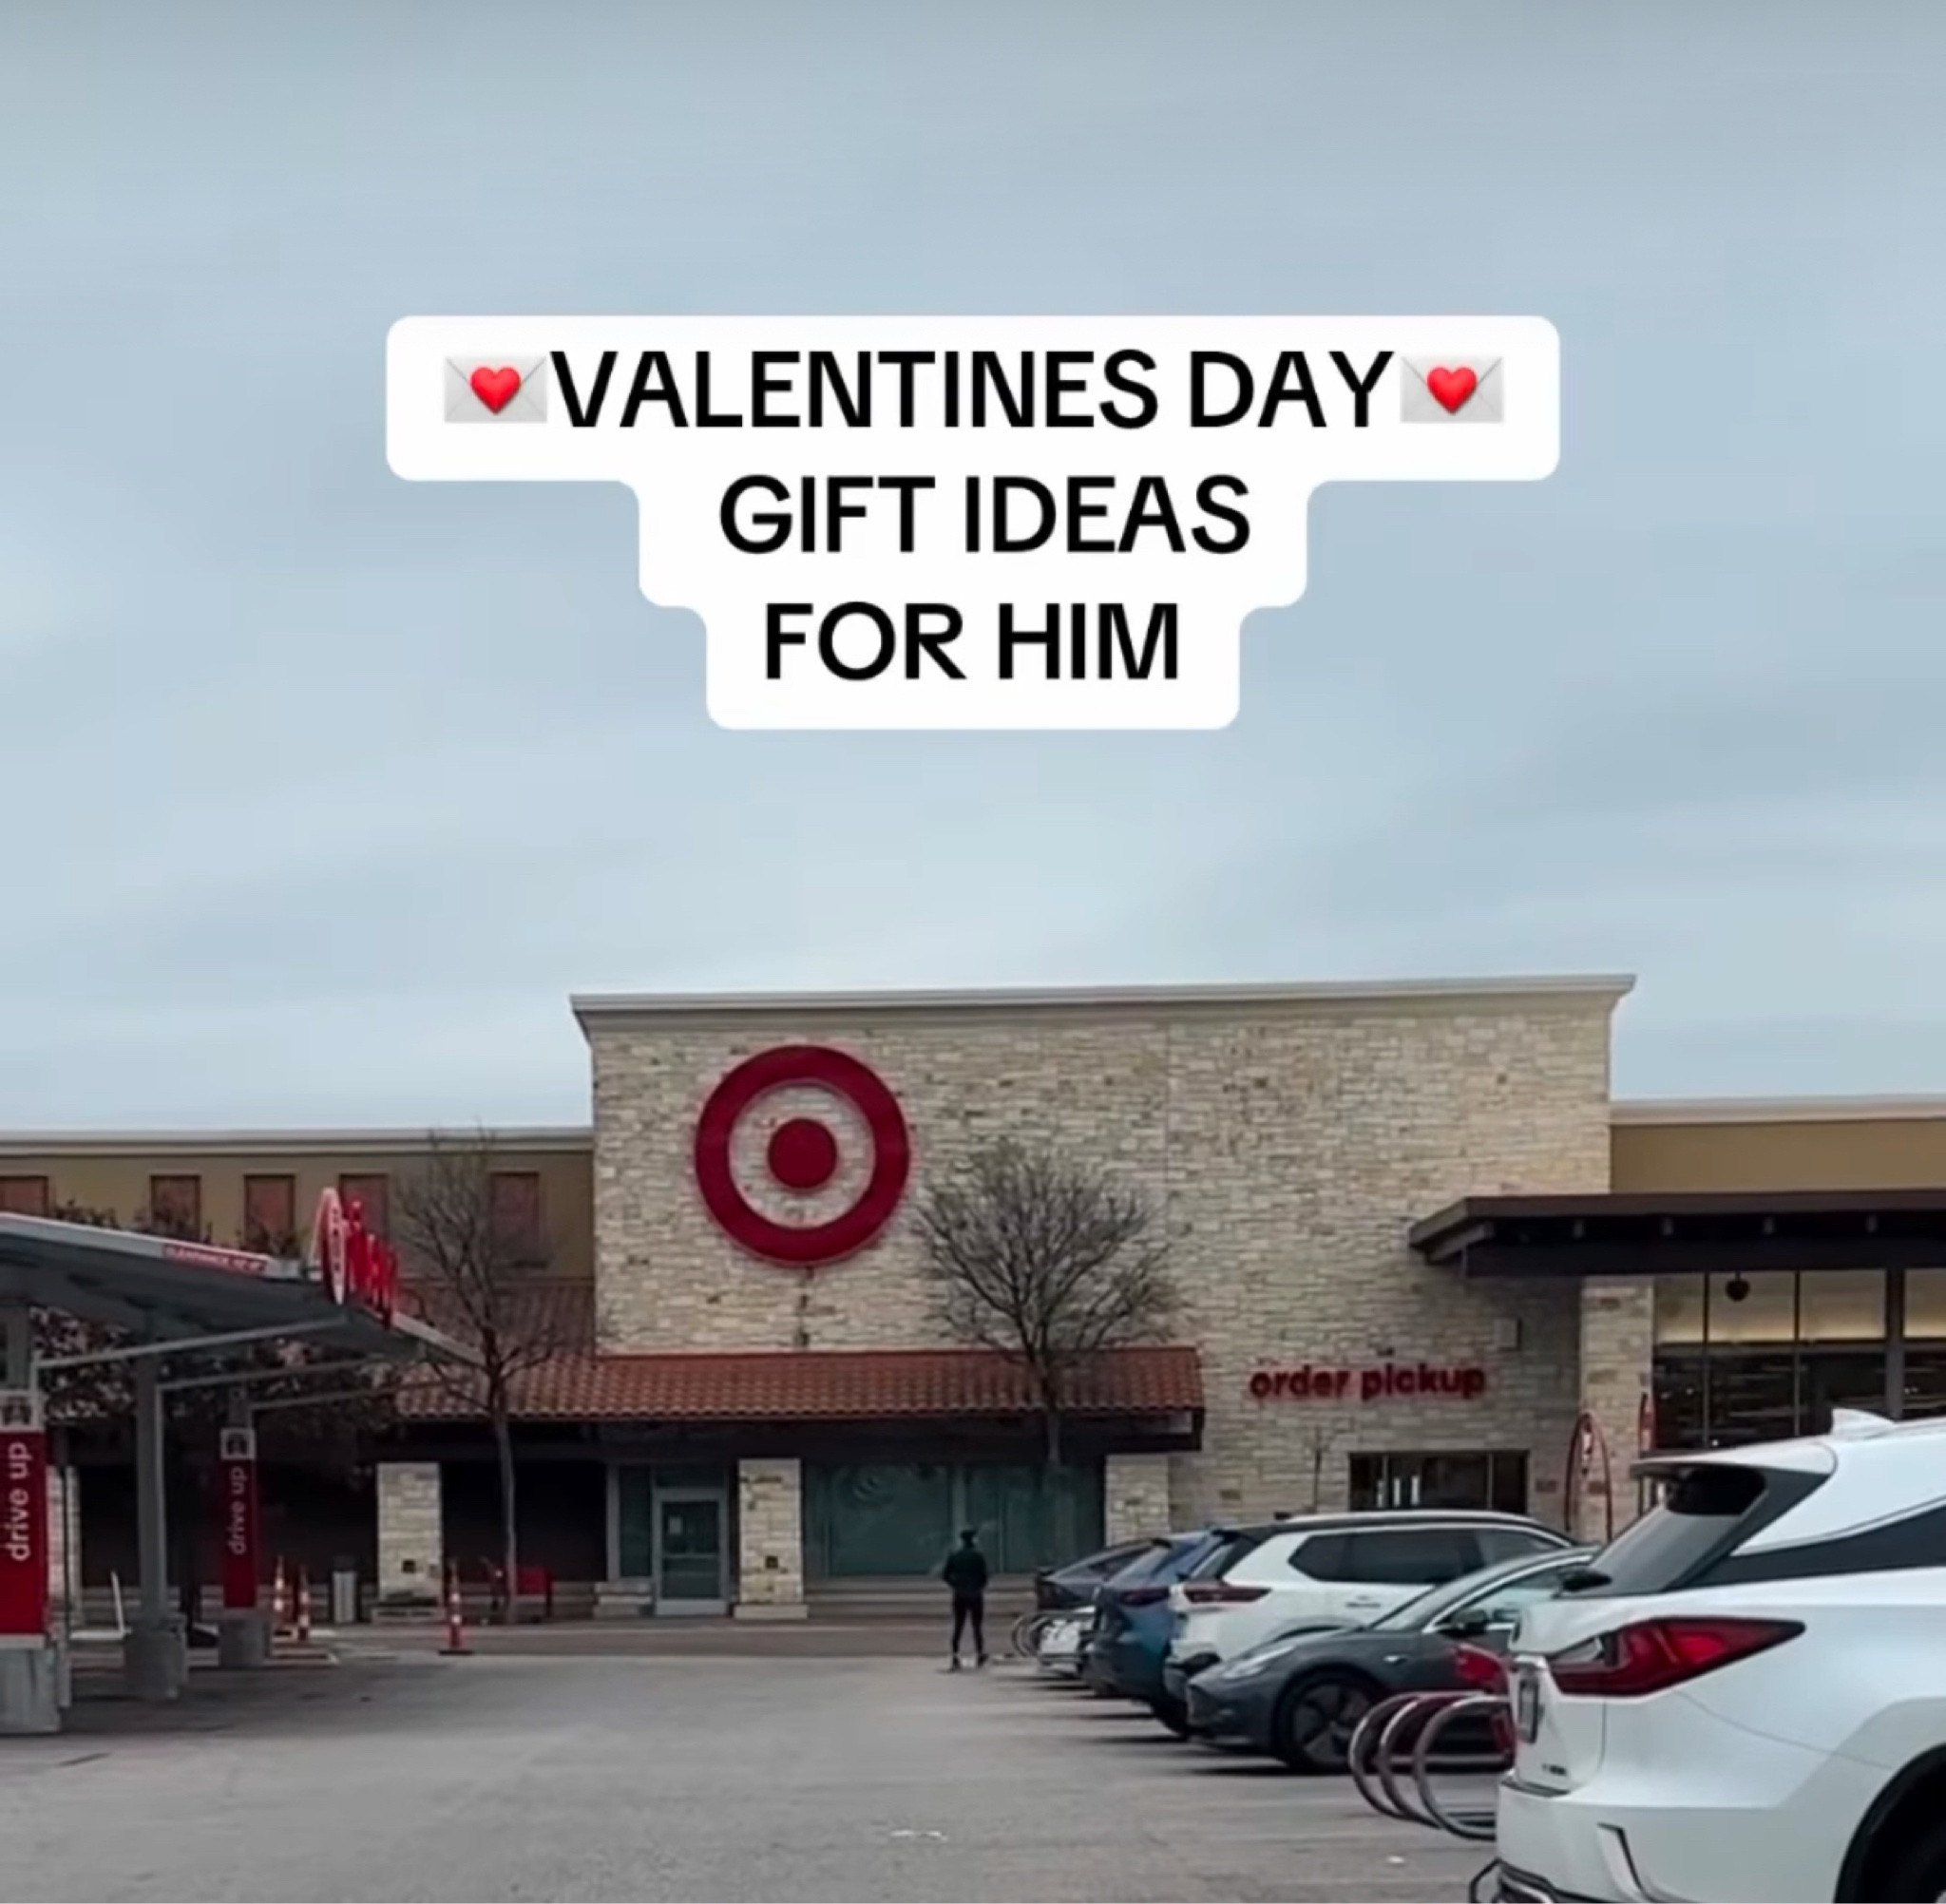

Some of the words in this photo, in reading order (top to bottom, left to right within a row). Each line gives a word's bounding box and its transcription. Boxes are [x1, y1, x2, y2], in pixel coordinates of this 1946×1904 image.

[1250, 1364, 1350, 1399] order
[1361, 1362, 1485, 1400] pickup
[8, 1441, 32, 1479] up
[230, 1466, 247, 1495] up
[5, 1488, 31, 1561] drive
[226, 1500, 247, 1555] drive
